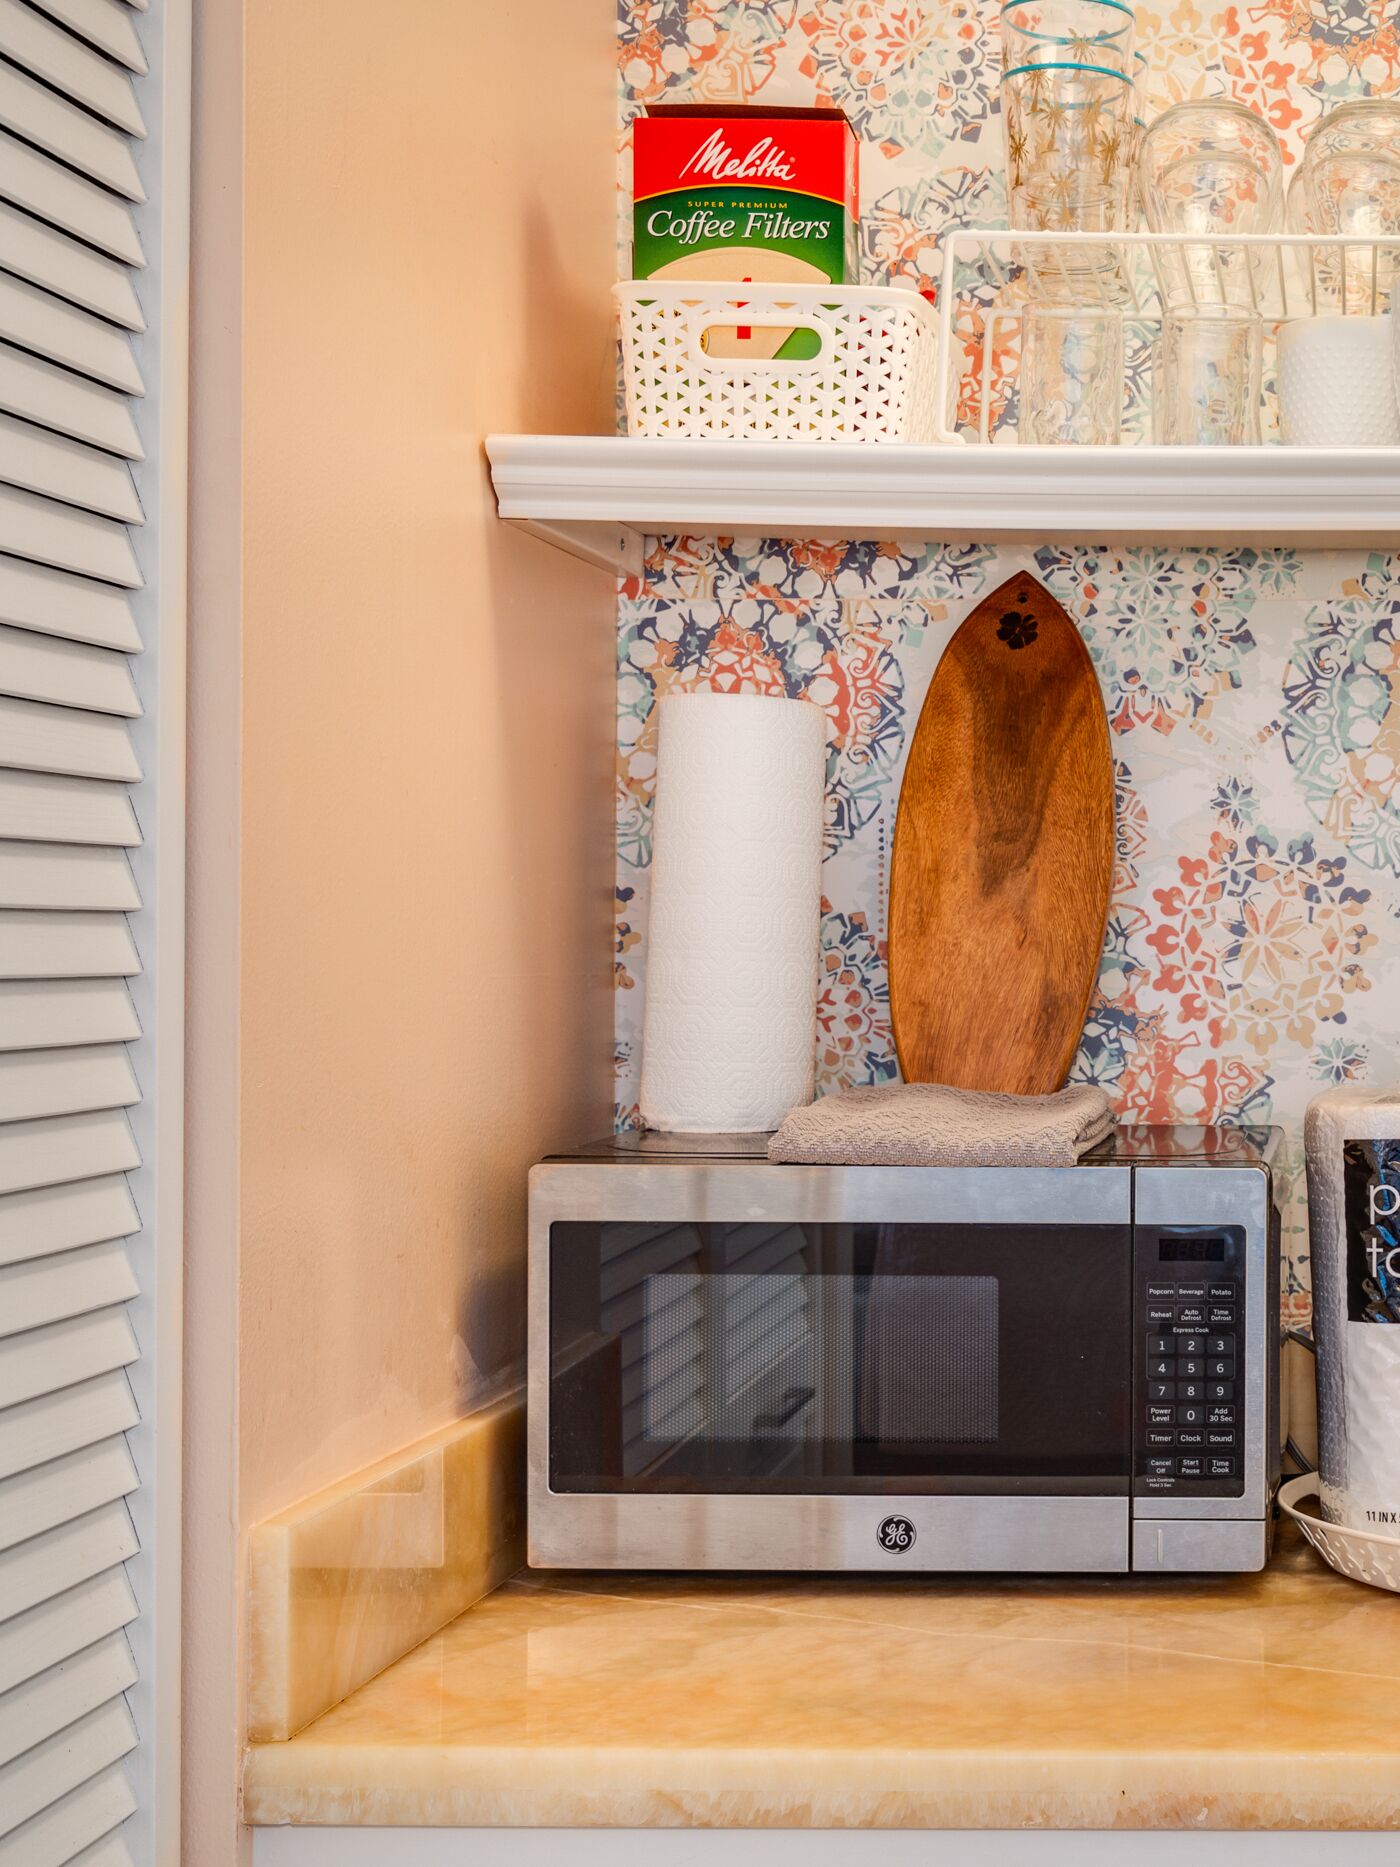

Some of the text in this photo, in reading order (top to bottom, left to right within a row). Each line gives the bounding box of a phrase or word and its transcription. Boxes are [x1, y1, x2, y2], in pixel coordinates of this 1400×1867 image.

[679, 128, 796, 181] Melitta
[731, 201, 788, 209] PREMIUM
[647, 210, 831, 245] Coffee Filters
[1149, 1288, 1174, 1296] Popcorn
[1178, 1288, 1204, 1296] Beverage
[1159, 1341, 1165, 1351] 1
[1187, 1341, 1195, 1351] 2
[1217, 1341, 1224, 1351] 3
[1158, 1363, 1166, 1373] 4
[1187, 1363, 1195, 1373] 5
[1216, 1363, 1224, 1373] 6
[1158, 1386, 1166, 1396] 7
[1187, 1386, 1195, 1396] 8
[1216, 1386, 1224, 1396] 9
[1187, 1410, 1195, 1421] 0
[1180, 1434, 1201, 1442] Clock
[1209, 1434, 1232, 1442] Sound
[1366, 1510, 1376, 1522] 11
[1379, 1511, 1389, 1523] IN
[1390, 1512, 1397, 1523] X
